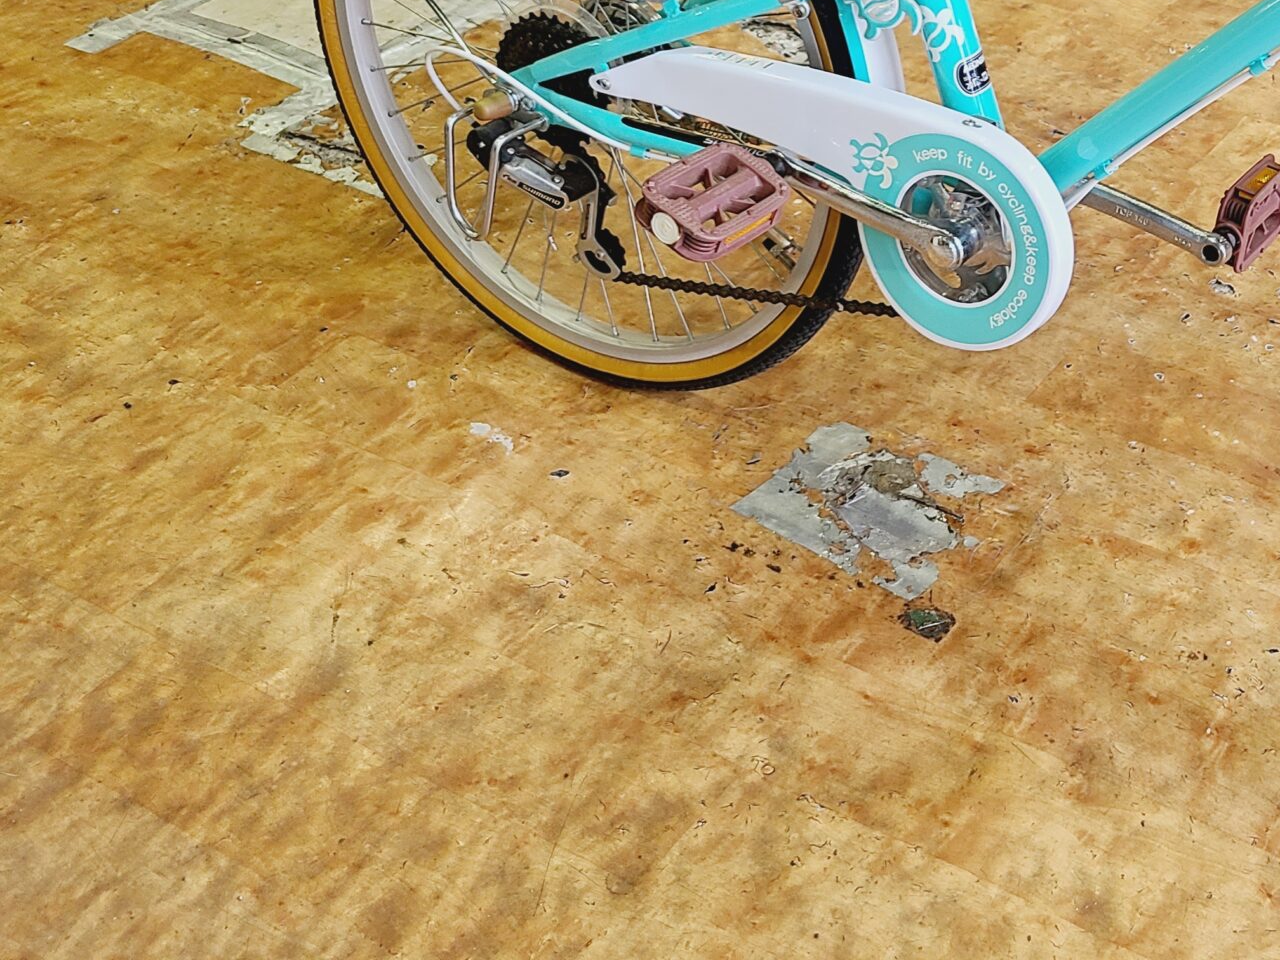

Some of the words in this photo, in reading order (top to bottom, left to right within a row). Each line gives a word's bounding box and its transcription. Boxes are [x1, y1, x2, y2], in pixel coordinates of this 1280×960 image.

[912, 147, 948, 163] keep
[956, 150, 974, 169] fit
[977, 161, 997, 181] by
[997, 182, 1040, 286] cycling&keep
[989, 289, 1028, 329] ecology
